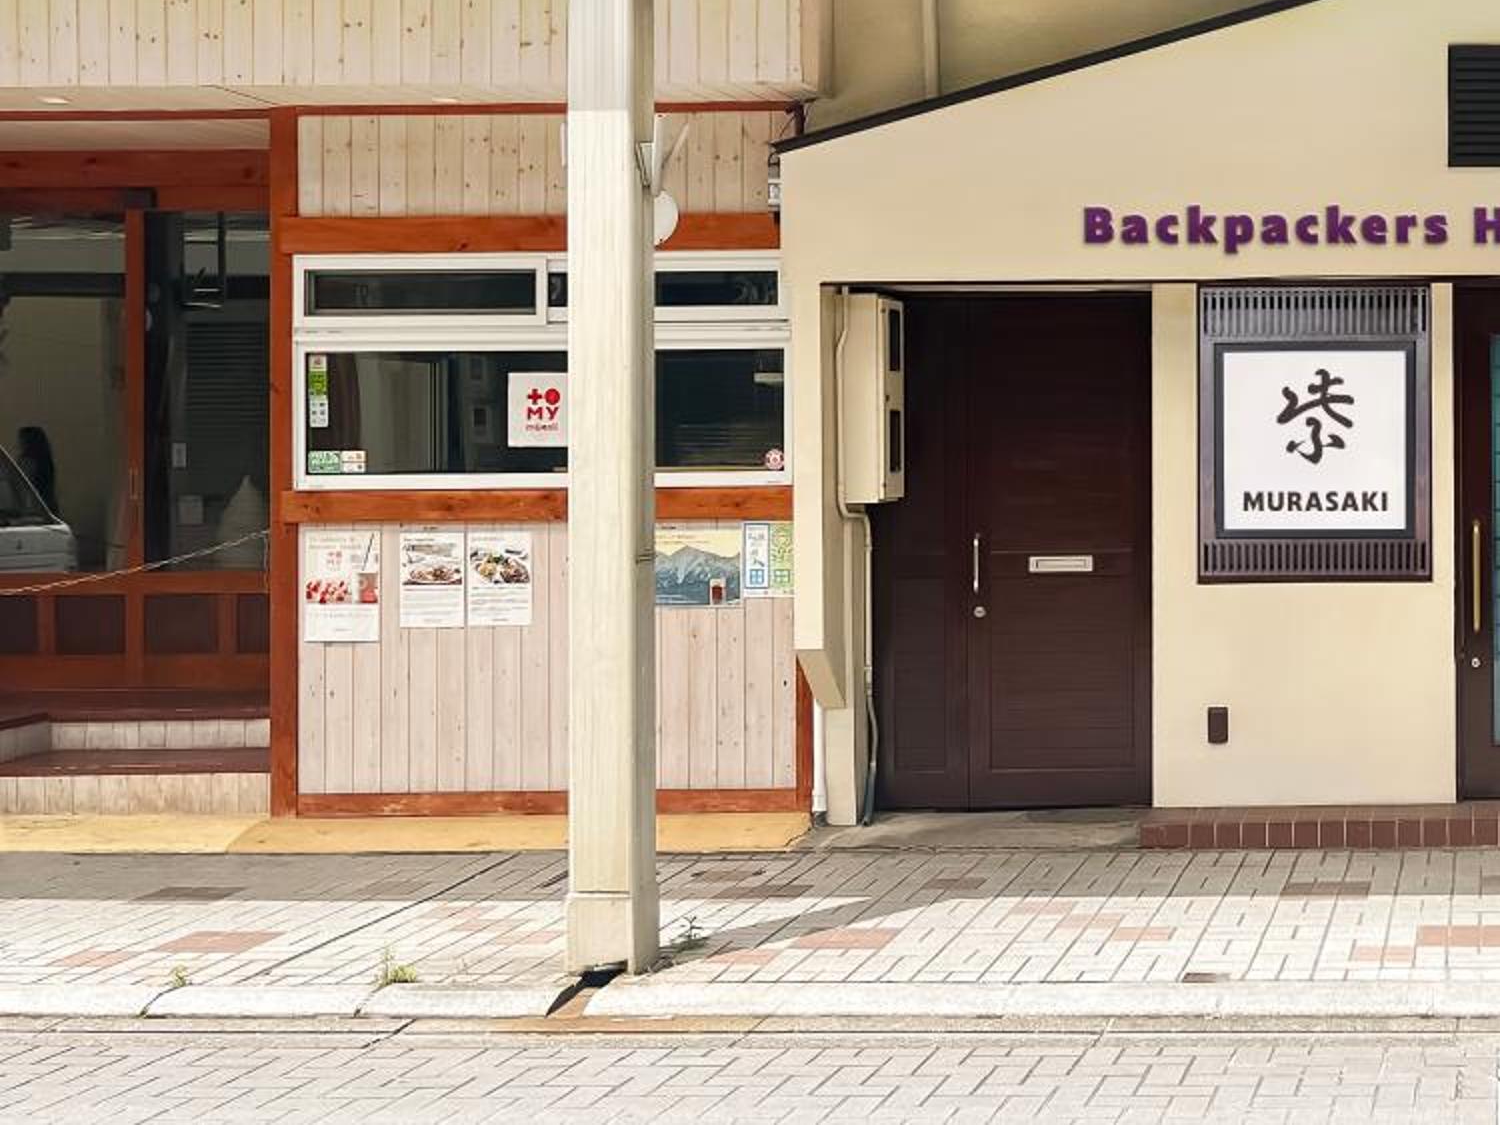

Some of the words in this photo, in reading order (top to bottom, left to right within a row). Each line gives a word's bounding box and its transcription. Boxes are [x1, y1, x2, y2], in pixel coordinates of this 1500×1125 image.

[1083, 204, 1449, 254] Backpackers
[527, 406, 559, 421] MY
[1276, 368, 1355, 465] 紫
[1243, 491, 1387, 512] MURASAKI
